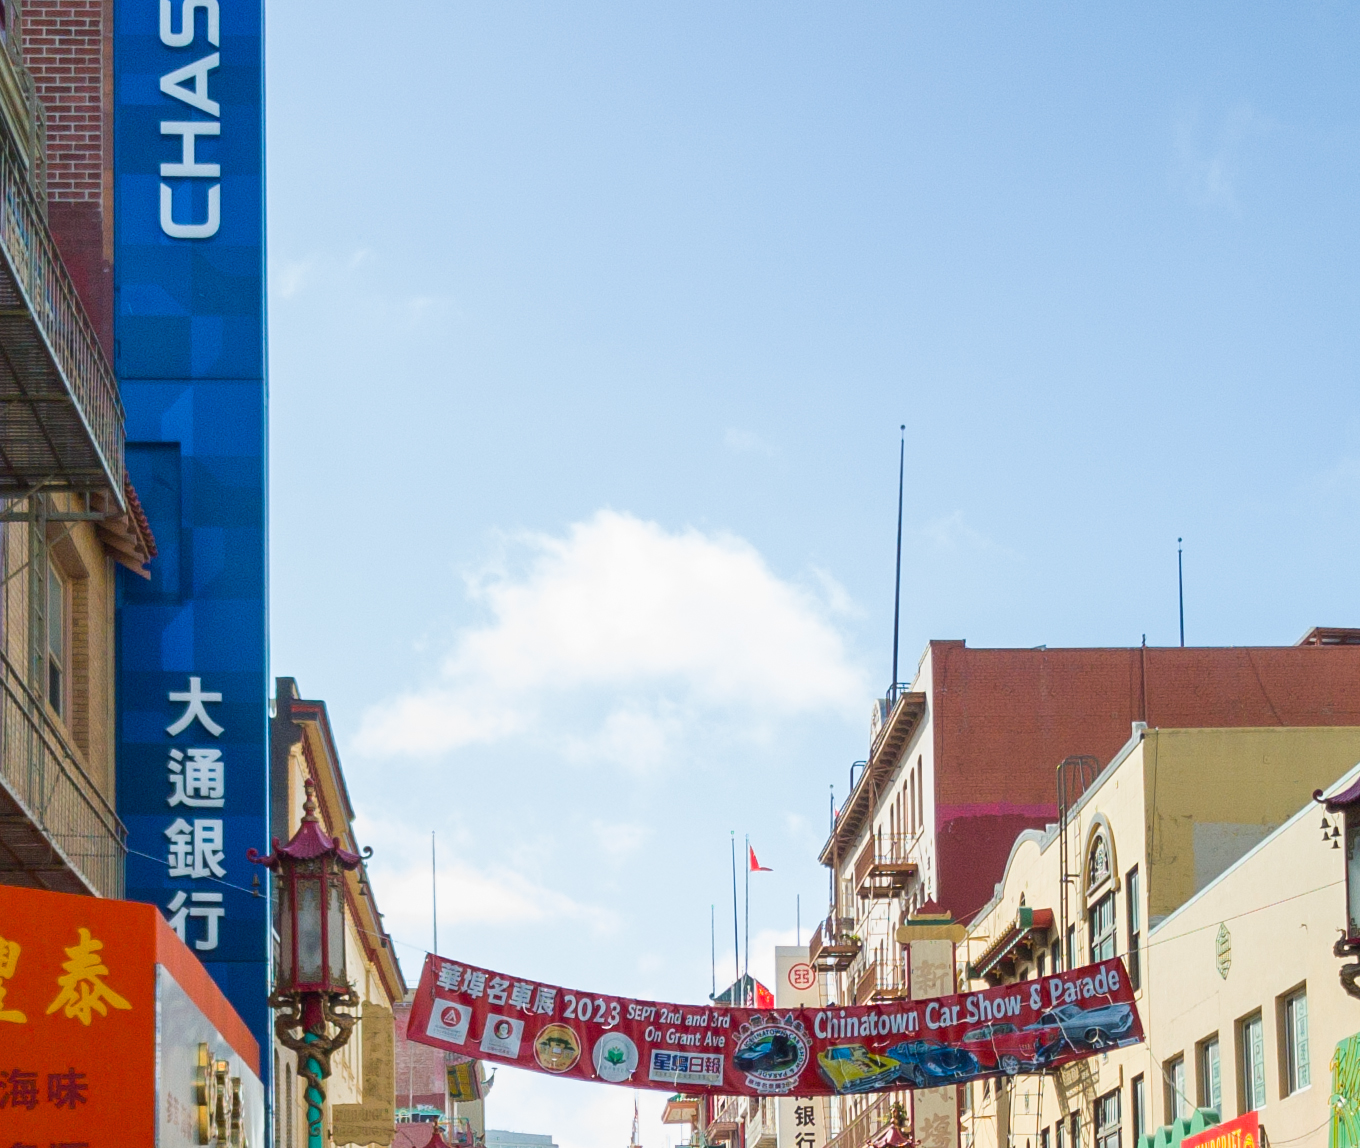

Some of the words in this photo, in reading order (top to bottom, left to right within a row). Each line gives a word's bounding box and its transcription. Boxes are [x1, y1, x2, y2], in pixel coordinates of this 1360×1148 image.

[164, 676, 227, 951] 大通銀行
[436, 961, 558, 1017] 華埠名車展
[914, 959, 949, 999] 新
[562, 994, 621, 1027] 2023
[626, 1003, 657, 1023] SEPT
[659, 1009, 682, 1026] 2nd
[684, 1011, 708, 1028] and
[710, 1012, 731, 1029] 3rd
[813, 1010, 919, 1040] Chinatown
[925, 1001, 960, 1030] Car
[966, 994, 1022, 1025] Show
[1029, 986, 1042, 1011] &
[1049, 964, 1121, 1006] Parade
[643, 1026, 662, 1043] On
[665, 1028, 701, 1046] Grant
[703, 1031, 726, 1048] Ave
